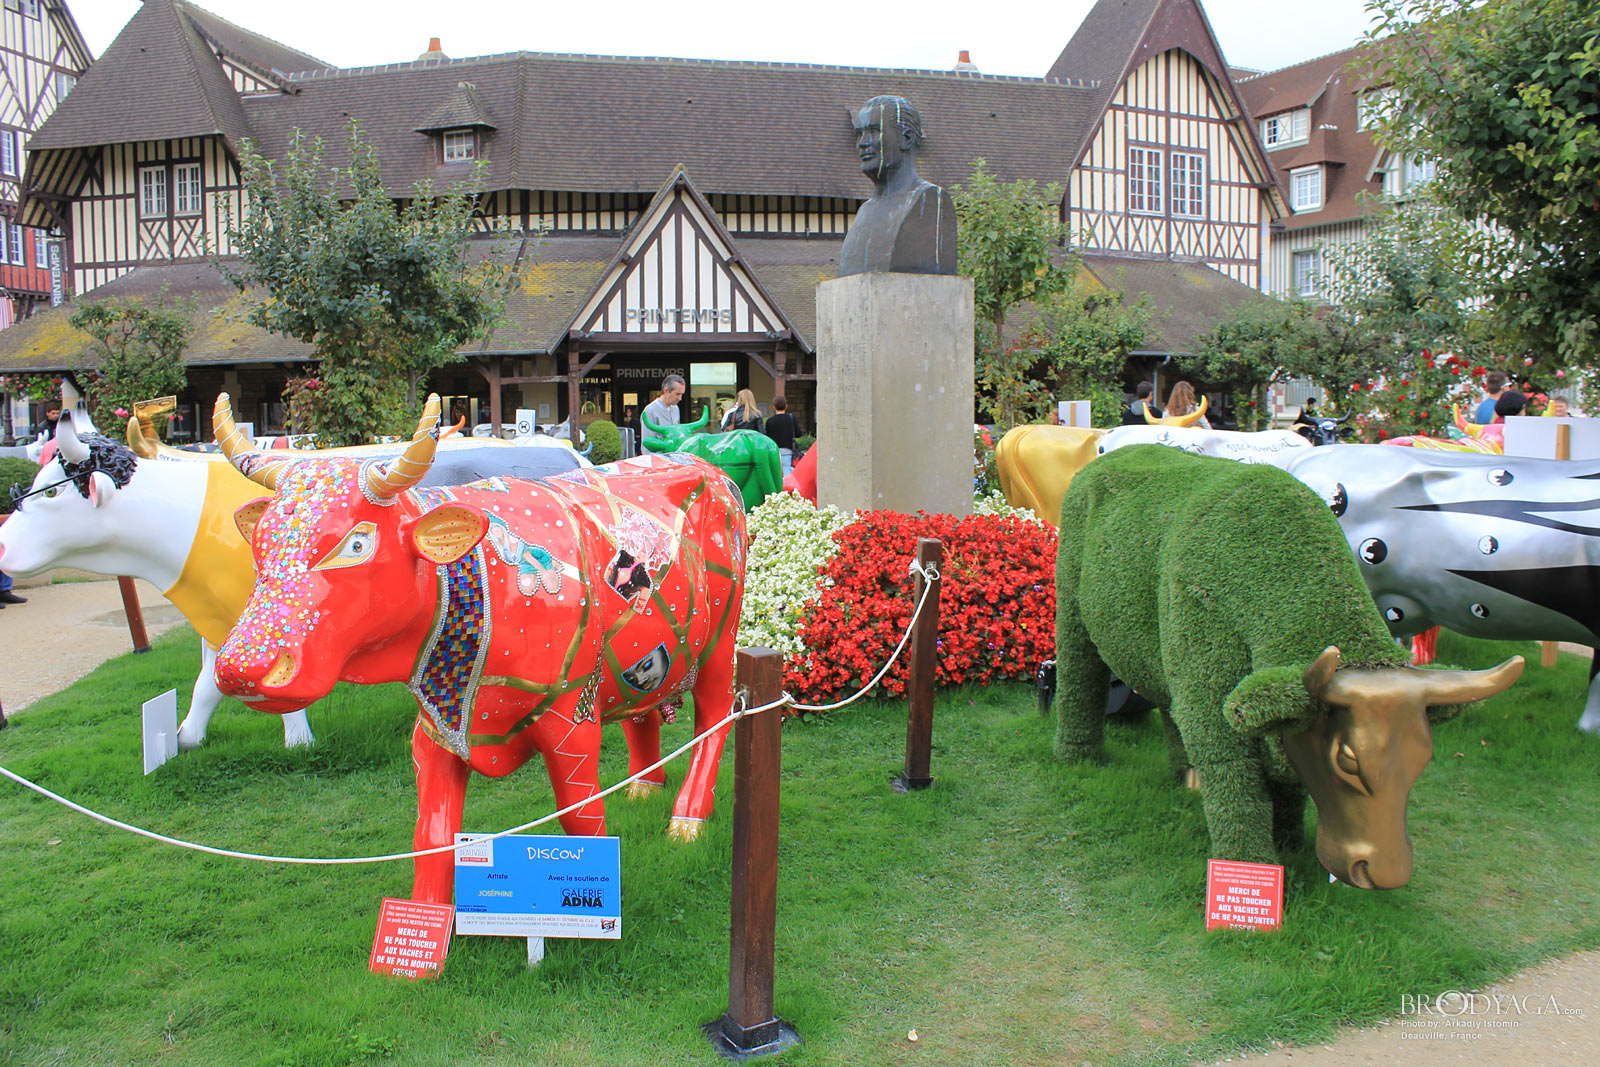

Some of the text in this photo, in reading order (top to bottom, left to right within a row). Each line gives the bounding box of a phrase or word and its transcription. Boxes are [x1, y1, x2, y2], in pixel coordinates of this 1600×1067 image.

[626, 308, 732, 323] PRINTEMPS
[616, 368, 684, 379] PRINTEMPS
[478, 889, 513, 898] JOSÉPHINE
[561, 888, 603, 898] GALERIE
[1228, 886, 1261, 896] MERCI DE
[561, 897, 603, 908] ADNA
[1227, 895, 1240, 903] PAS
[1242, 896, 1272, 906] TOUCHER
[1218, 904, 1231, 912] AUX
[1233, 905, 1259, 915] VACHES
[1211, 912, 1275, 925] DE NE PAS MONTER
[397, 927, 428, 938] MERCI DE
[384, 936, 437, 949] NE PAS TOUCHER
[384, 946, 434, 959] AUX VACHES ET
[376, 955, 438, 970] DE NE PAS MONTER
